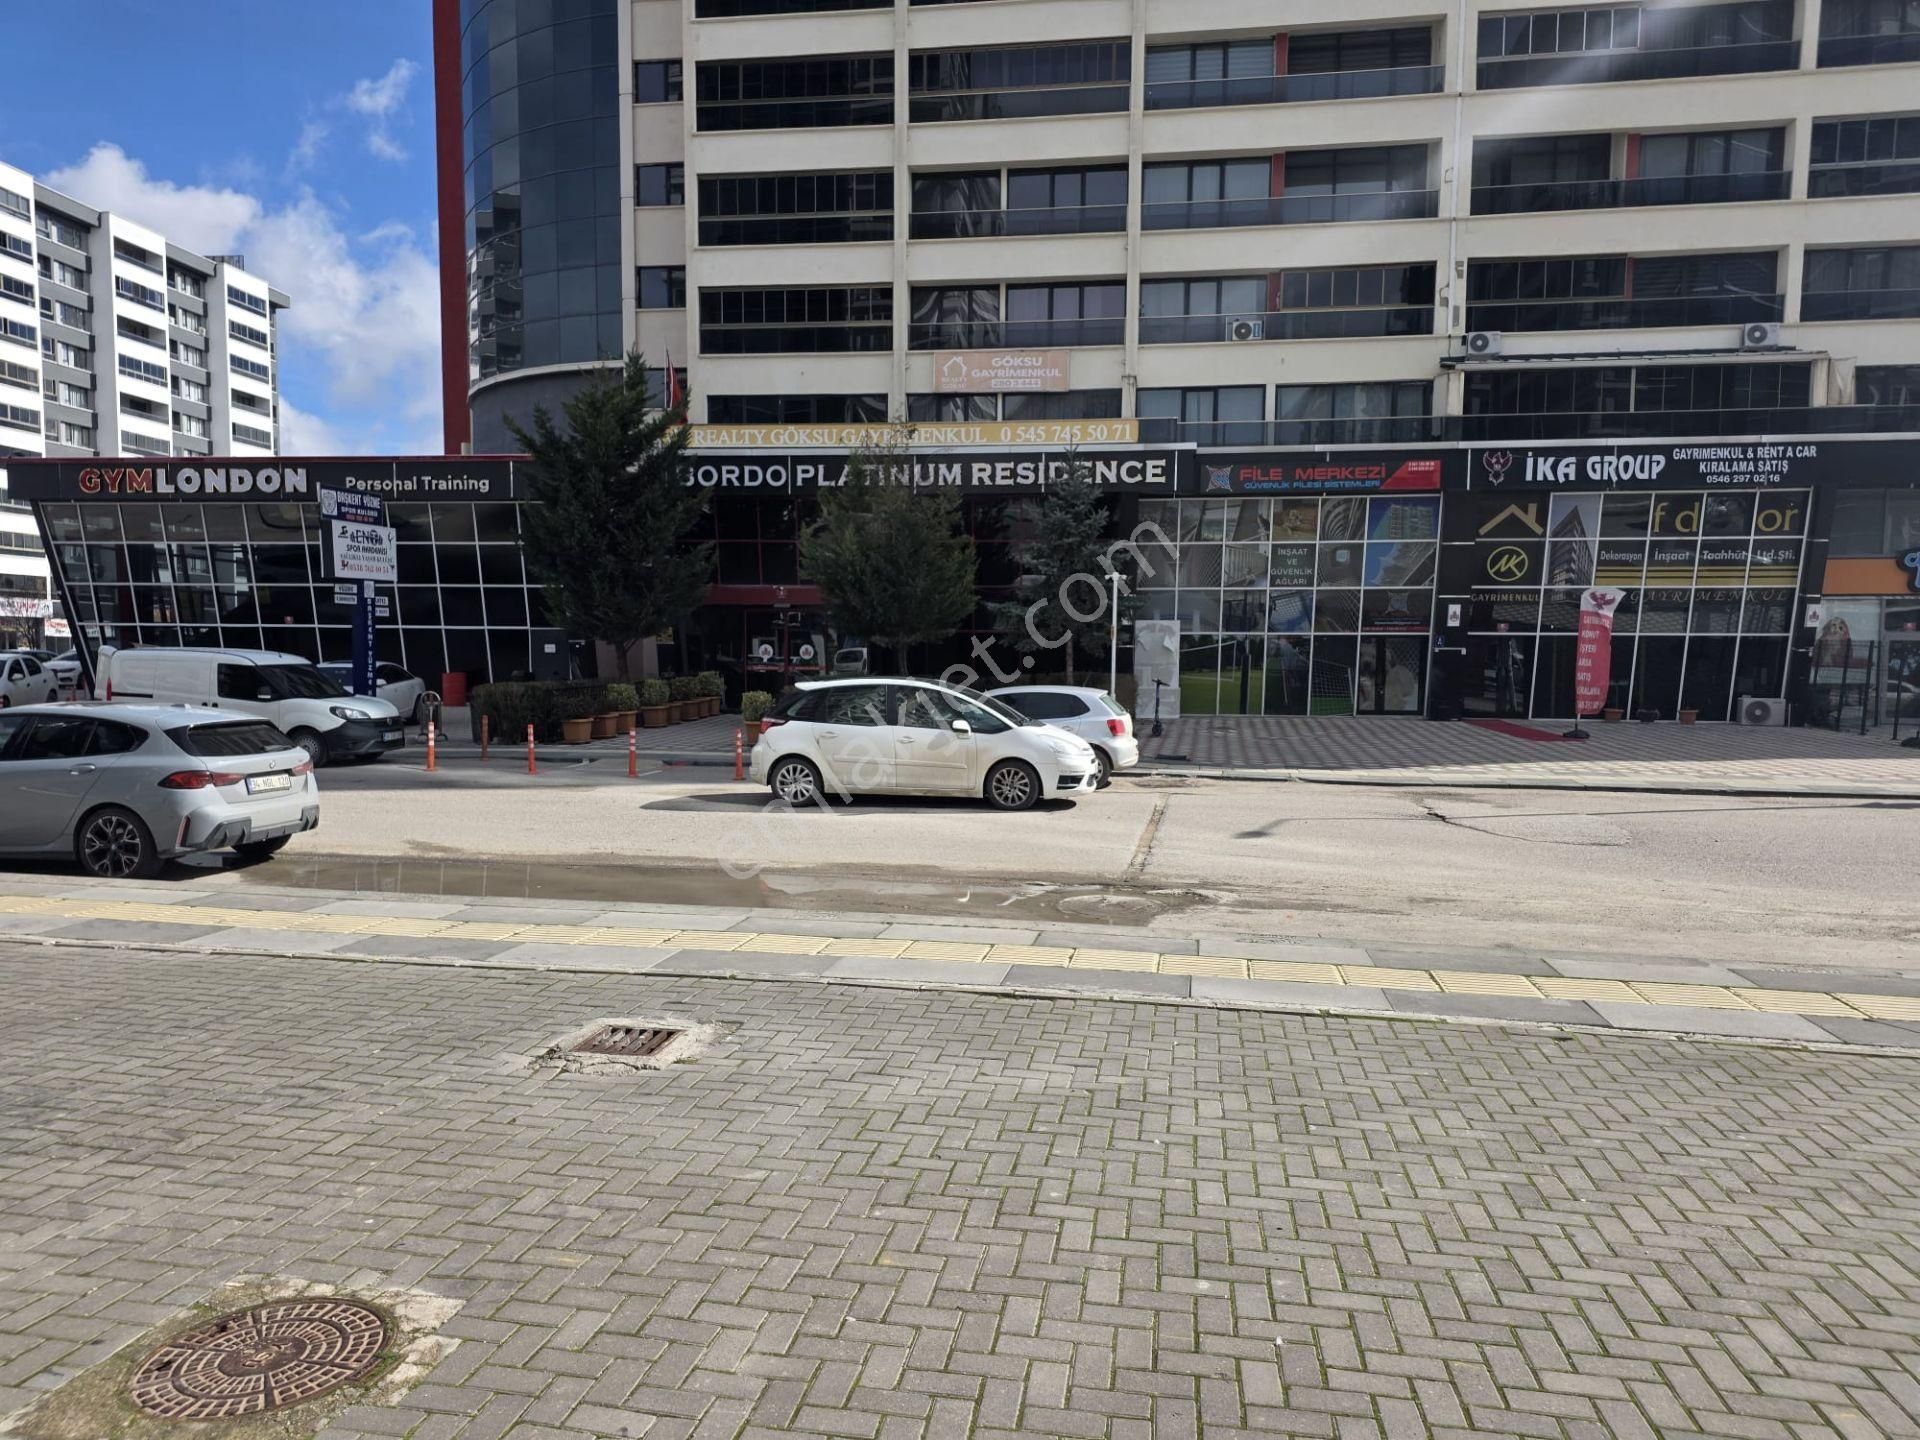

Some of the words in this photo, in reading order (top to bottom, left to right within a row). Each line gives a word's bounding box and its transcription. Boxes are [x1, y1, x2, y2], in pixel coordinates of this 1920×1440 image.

[991, 355, 1042, 367] GÖKSU
[694, 429, 765, 446] REALTY
[770, 426, 836, 445] GÖKSU
[1001, 427, 1011, 442] 0
[1016, 426, 1046, 442] 545
[1053, 425, 1082, 441] 745
[1087, 424, 1108, 441] 50
[1113, 424, 1132, 440] 71
[1747, 447, 1754, 458] &
[1757, 446, 1784, 458] RENT
[1786, 446, 1794, 458] A
[1796, 445, 1817, 457] CAR
[1239, 466, 1283, 481] FİLE
[1295, 462, 1386, 480] MERKEZİ
[1525, 451, 1577, 483] İKA
[1586, 454, 1666, 484] GROUP
[1699, 461, 1755, 473] KIRALAMA
[1758, 460, 1789, 474] SATIŞ
[346, 475, 417, 491] Personal
[420, 475, 490, 493] Training
[1706, 475, 1730, 483] 0546
[1732, 475, 1751, 483] 297
[1753, 474, 1765, 482] 02
[1769, 474, 1780, 482] 16
[1277, 547, 1308, 556] İNŞAAT
[1600, 550, 1642, 561] Dekorasyon
[1654, 548, 1690, 562] İnşaat
